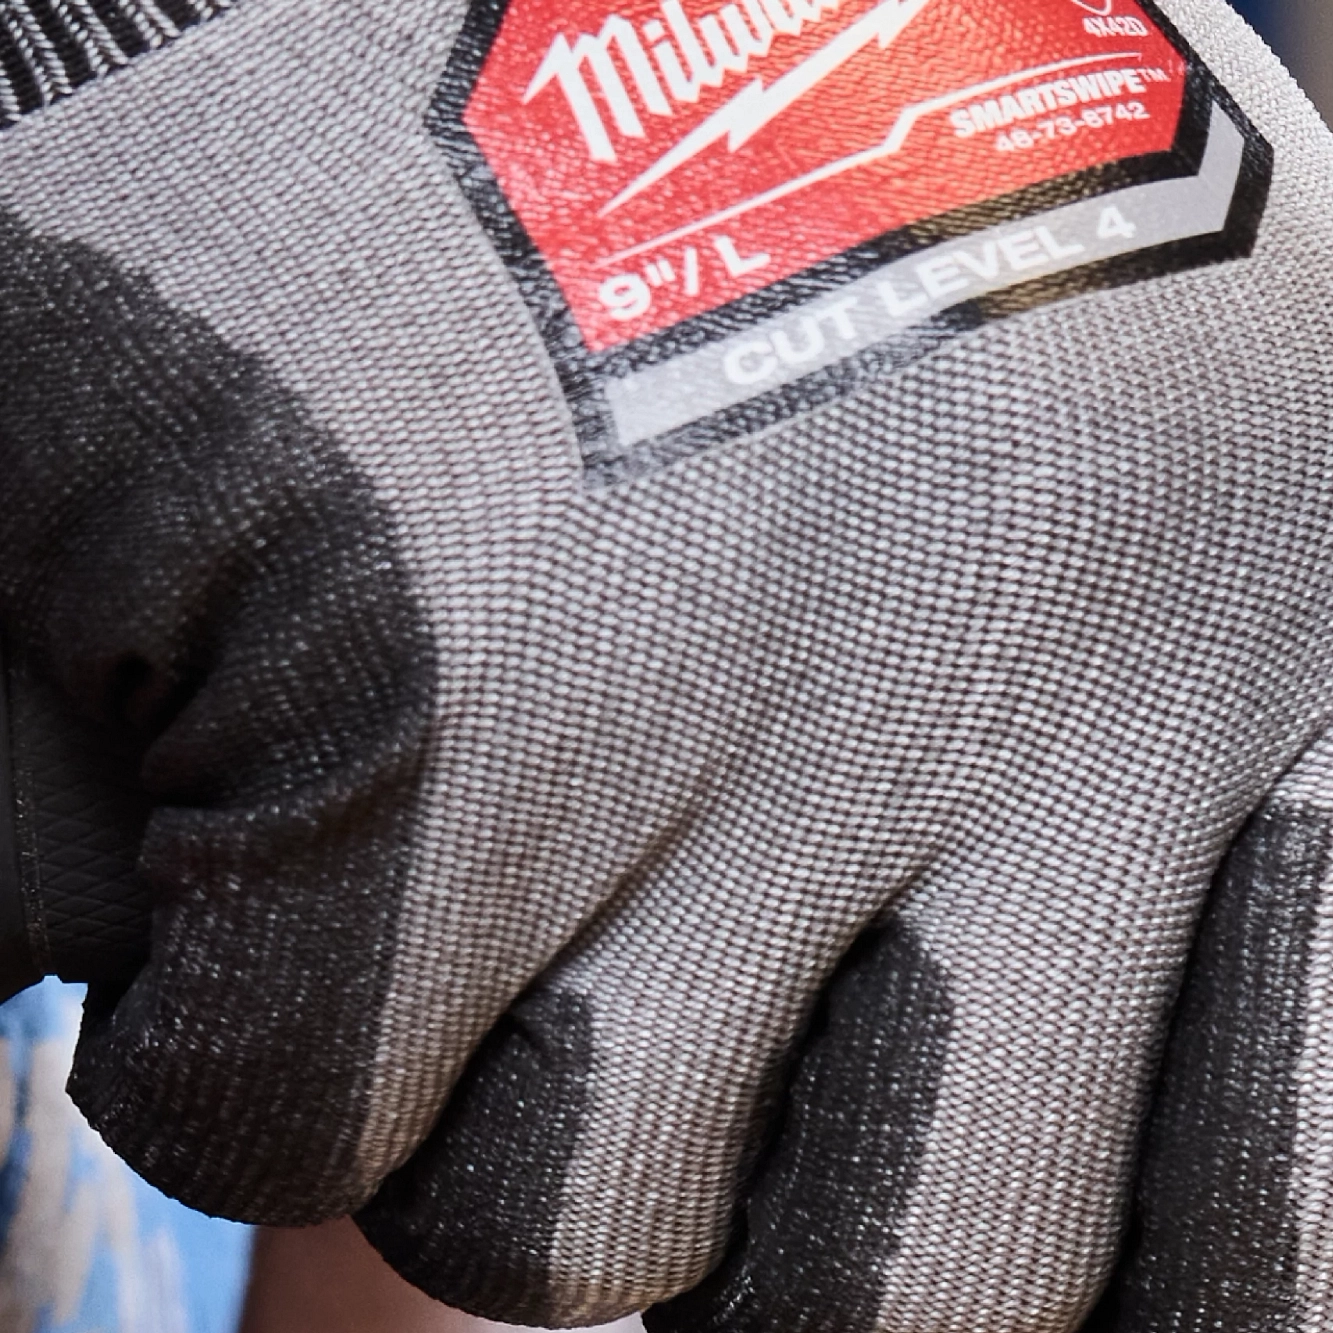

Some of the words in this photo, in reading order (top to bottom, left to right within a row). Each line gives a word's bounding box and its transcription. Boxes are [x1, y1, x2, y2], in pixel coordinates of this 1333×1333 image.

[1083, 16, 1149, 37] 4X42D
[995, 102, 1150, 151] 48-73-8742
[712, 232, 772, 277] L
[720, 298, 865, 388] CUT
[885, 221, 1083, 317] LEVEL
[1092, 205, 1140, 240] 4
